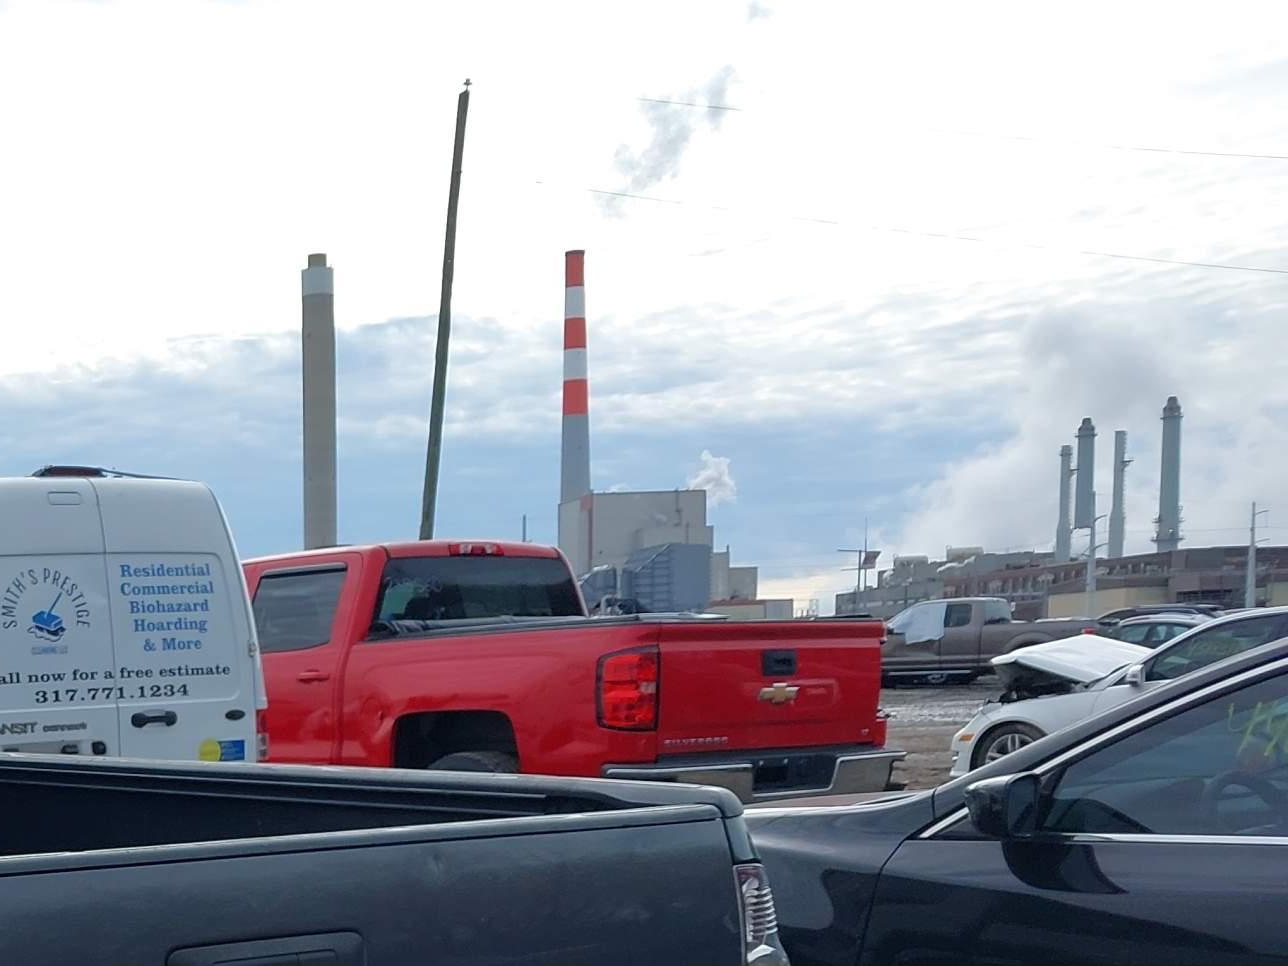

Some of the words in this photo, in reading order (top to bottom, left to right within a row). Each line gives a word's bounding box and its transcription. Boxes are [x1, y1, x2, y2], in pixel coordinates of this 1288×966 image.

[120, 563, 211, 578] Residential
[120, 581, 214, 596] Commercial
[0, 569, 38, 629] SMITH'S
[43, 568, 90, 628] PRESTIGE
[130, 600, 209, 614] Biohazard
[134, 618, 209, 633] Hoarding
[143, 638, 156, 652] &
[162, 638, 202, 651] More
[27, 673, 66, 684] now
[72, 669, 98, 681] for
[103, 670, 114, 680] a
[120, 666, 153, 679] free
[159, 664, 231, 678] estimate
[35, 684, 190, 704] 317.771.1234
